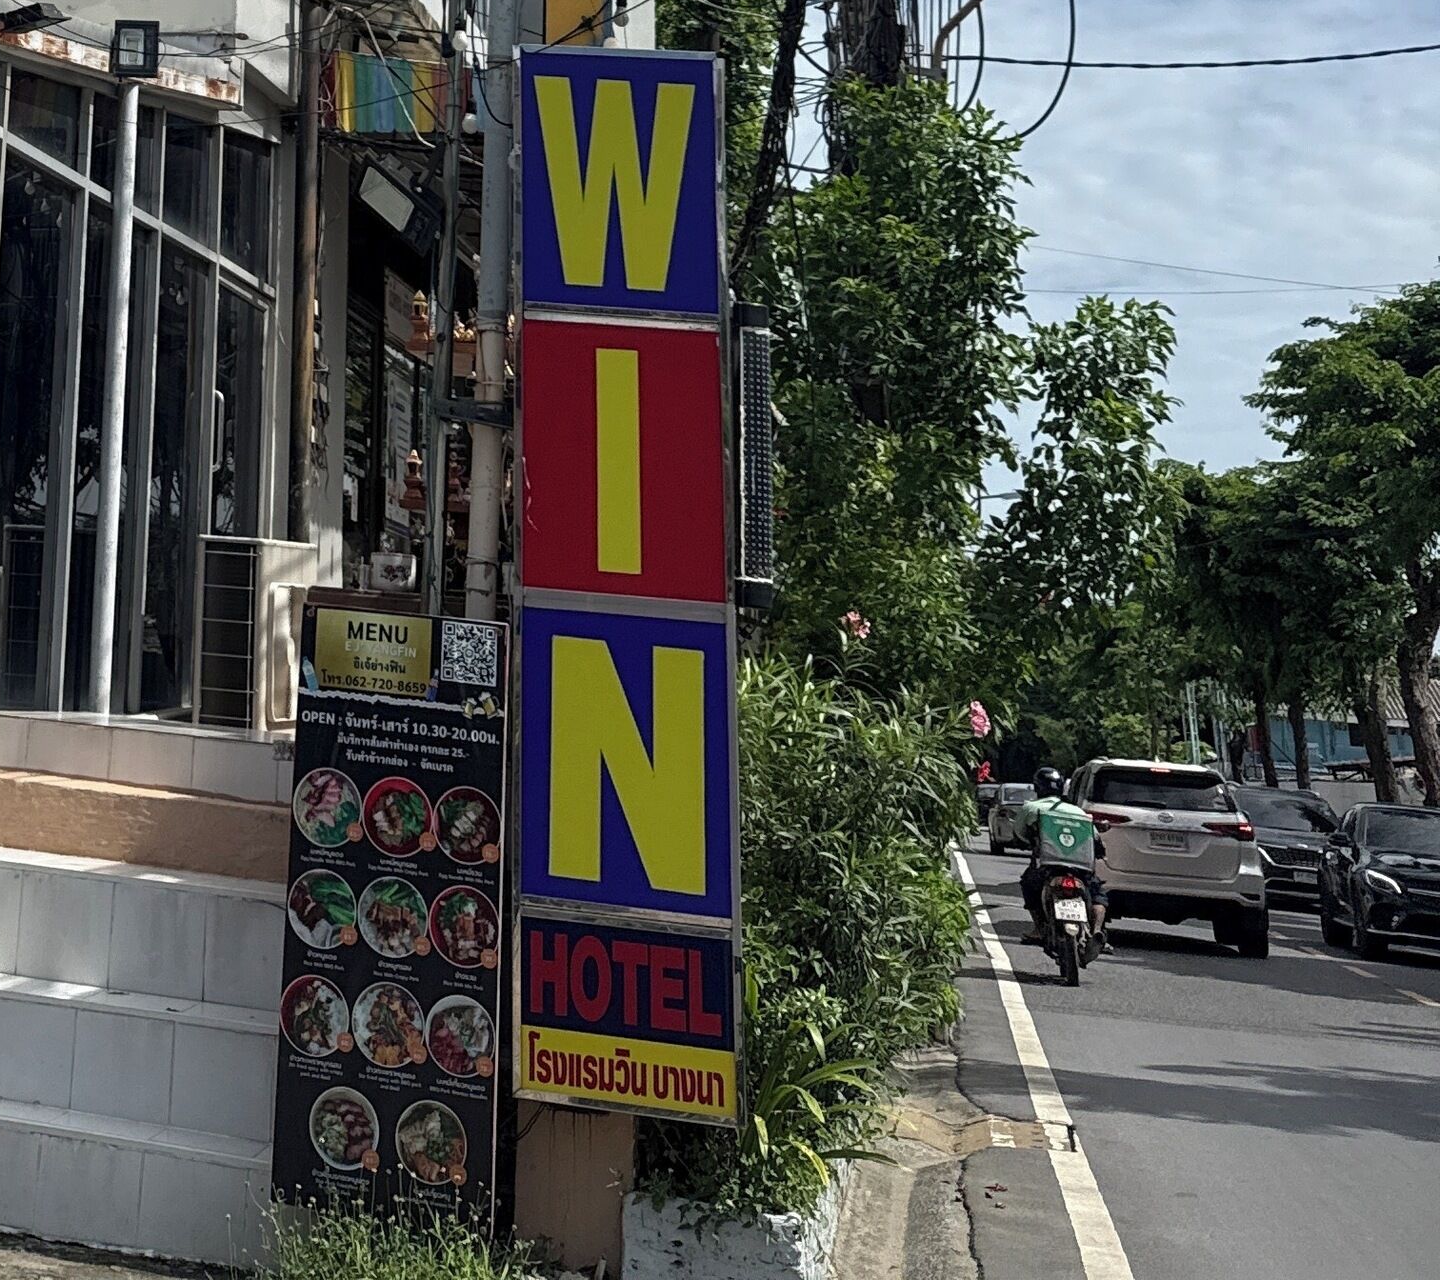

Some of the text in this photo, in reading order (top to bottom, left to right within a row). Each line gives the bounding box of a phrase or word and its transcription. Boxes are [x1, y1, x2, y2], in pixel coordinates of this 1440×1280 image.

[347, 620, 409, 645] MENU
[301, 710, 336, 726] OPEN
[530, 931, 723, 1038] HOTEL
[528, 1030, 648, 1097] โรงแรมวิน
[653, 1064, 725, 1108] บางนา
